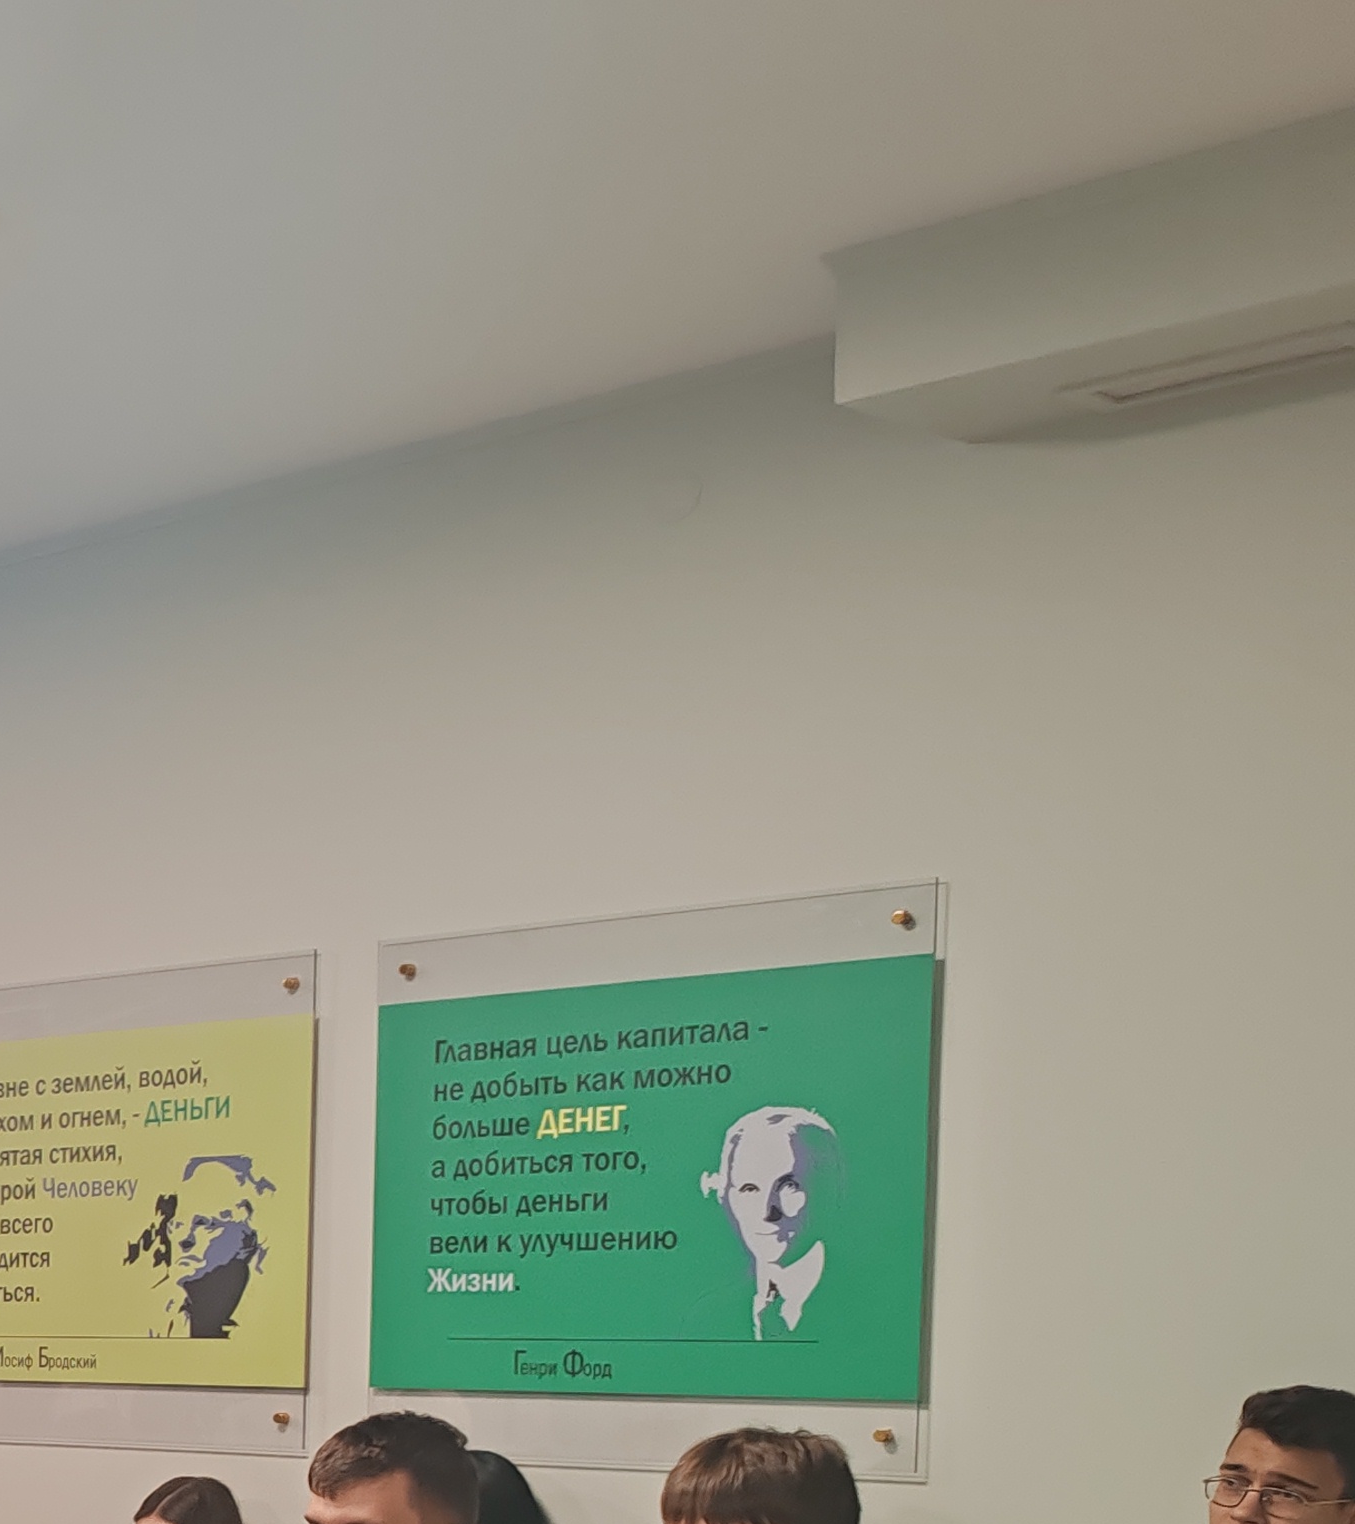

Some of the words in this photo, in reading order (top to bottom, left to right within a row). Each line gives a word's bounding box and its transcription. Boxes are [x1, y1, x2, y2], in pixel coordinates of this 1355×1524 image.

[434, 1036, 537, 1064] Главная
[546, 1029, 608, 1060] цель
[617, 1018, 749, 1050] капитала
[36, 1080, 46, 1095] с
[51, 1066, 131, 1094] землей,
[138, 1060, 208, 1088] водой,
[433, 1080, 464, 1104] не
[470, 1070, 567, 1101] добыть
[576, 1070, 626, 1094] как
[633, 1062, 732, 1090] можно
[41, 1113, 52, 1130] и
[59, 1107, 127, 1128] огнем,
[144, 1096, 230, 1127] ДЕНЬГИ
[432, 1112, 530, 1141] больше
[536, 1105, 629, 1140] ДЕНЕГ,
[49, 1144, 122, 1165] стихия,
[431, 1159, 445, 1178] а
[453, 1149, 573, 1178] добиться
[582, 1151, 646, 1173] того,
[42, 1177, 138, 1200] Человеку
[430, 1191, 508, 1216] чтобы
[515, 1190, 608, 1217] деньги
[0, 1216, 53, 1235] всего
[429, 1233, 488, 1254] вели
[497, 1231, 512, 1252] к
[518, 1229, 678, 1259] улучшению
[427, 1267, 520, 1293] Жизни.
[38, 1347, 97, 1370] Бродский
[513, 1350, 557, 1379] Генри
[563, 1348, 613, 1379] Форд
